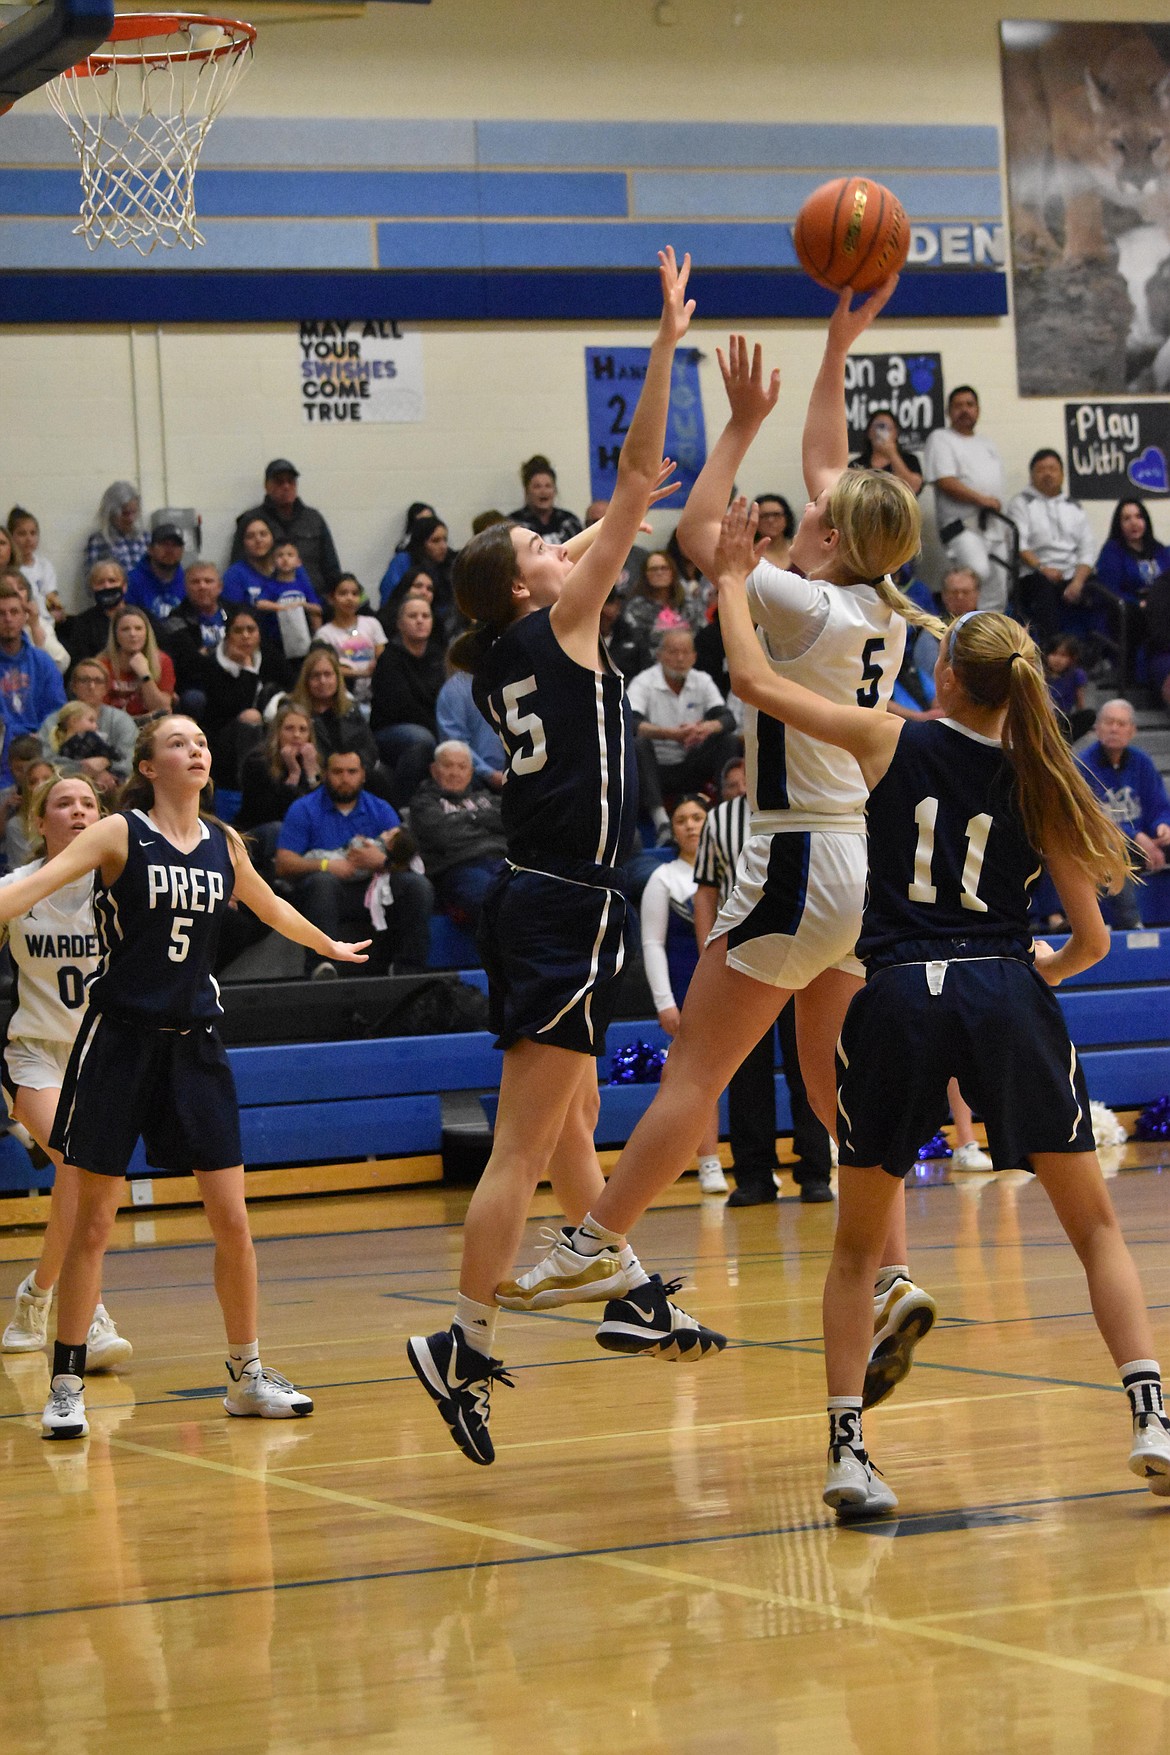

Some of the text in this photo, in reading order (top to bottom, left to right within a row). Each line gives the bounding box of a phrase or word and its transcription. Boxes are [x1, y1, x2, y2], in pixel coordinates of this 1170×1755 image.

[300, 321, 402, 338] MAY ALL
[300, 341, 360, 358] YOUR
[302, 361, 397, 378] SWISHES
[886, 356, 906, 387] a
[302, 381, 370, 398] COME
[303, 402, 361, 420] TRUE
[607, 395, 628, 434] 2
[1076, 405, 1139, 452] Play
[857, 638, 885, 708] 5
[908, 796, 993, 912] 11
[147, 864, 224, 914] PREP
[24, 934, 101, 959] WARDE
[168, 916, 194, 963] 5
[57, 966, 85, 1009] 0
